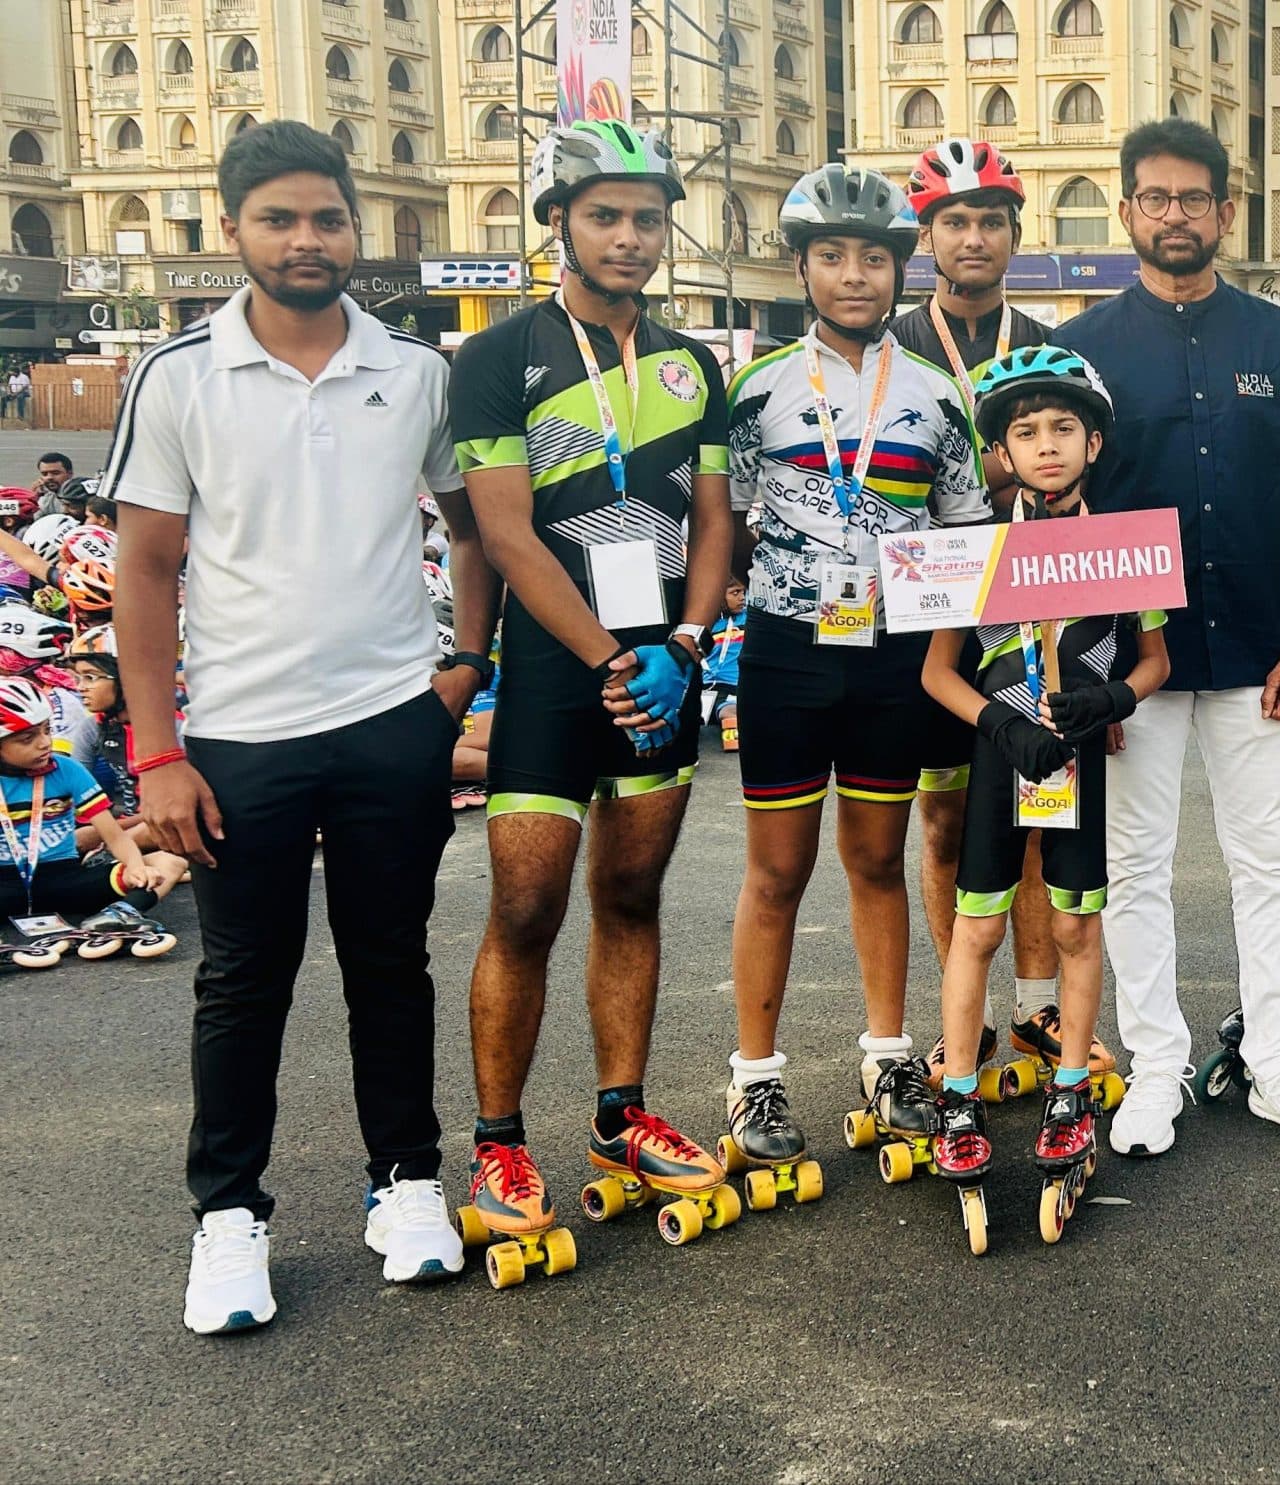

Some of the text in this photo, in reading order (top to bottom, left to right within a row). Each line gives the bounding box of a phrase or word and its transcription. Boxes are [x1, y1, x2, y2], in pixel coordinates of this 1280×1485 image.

[589, 0, 616, 18] INDIA
[589, 19, 617, 39] SKATE
[441, 263, 510, 284] DTDC
[1081, 267, 1096, 276] SBI
[165, 271, 252, 289] TIME COLLEC
[1235, 372, 1271, 385] INDIA
[1237, 382, 1274, 397] SKATE
[766, 477, 832, 516] ESCAPE
[82, 540, 106, 559] 827
[1010, 545, 1172, 588] JHARKHAND
[919, 592, 949, 601] INDIA
[919, 600, 951, 609] SKATE
[835, 616, 867, 627] GOA
[1035, 797, 1067, 809] GOA
